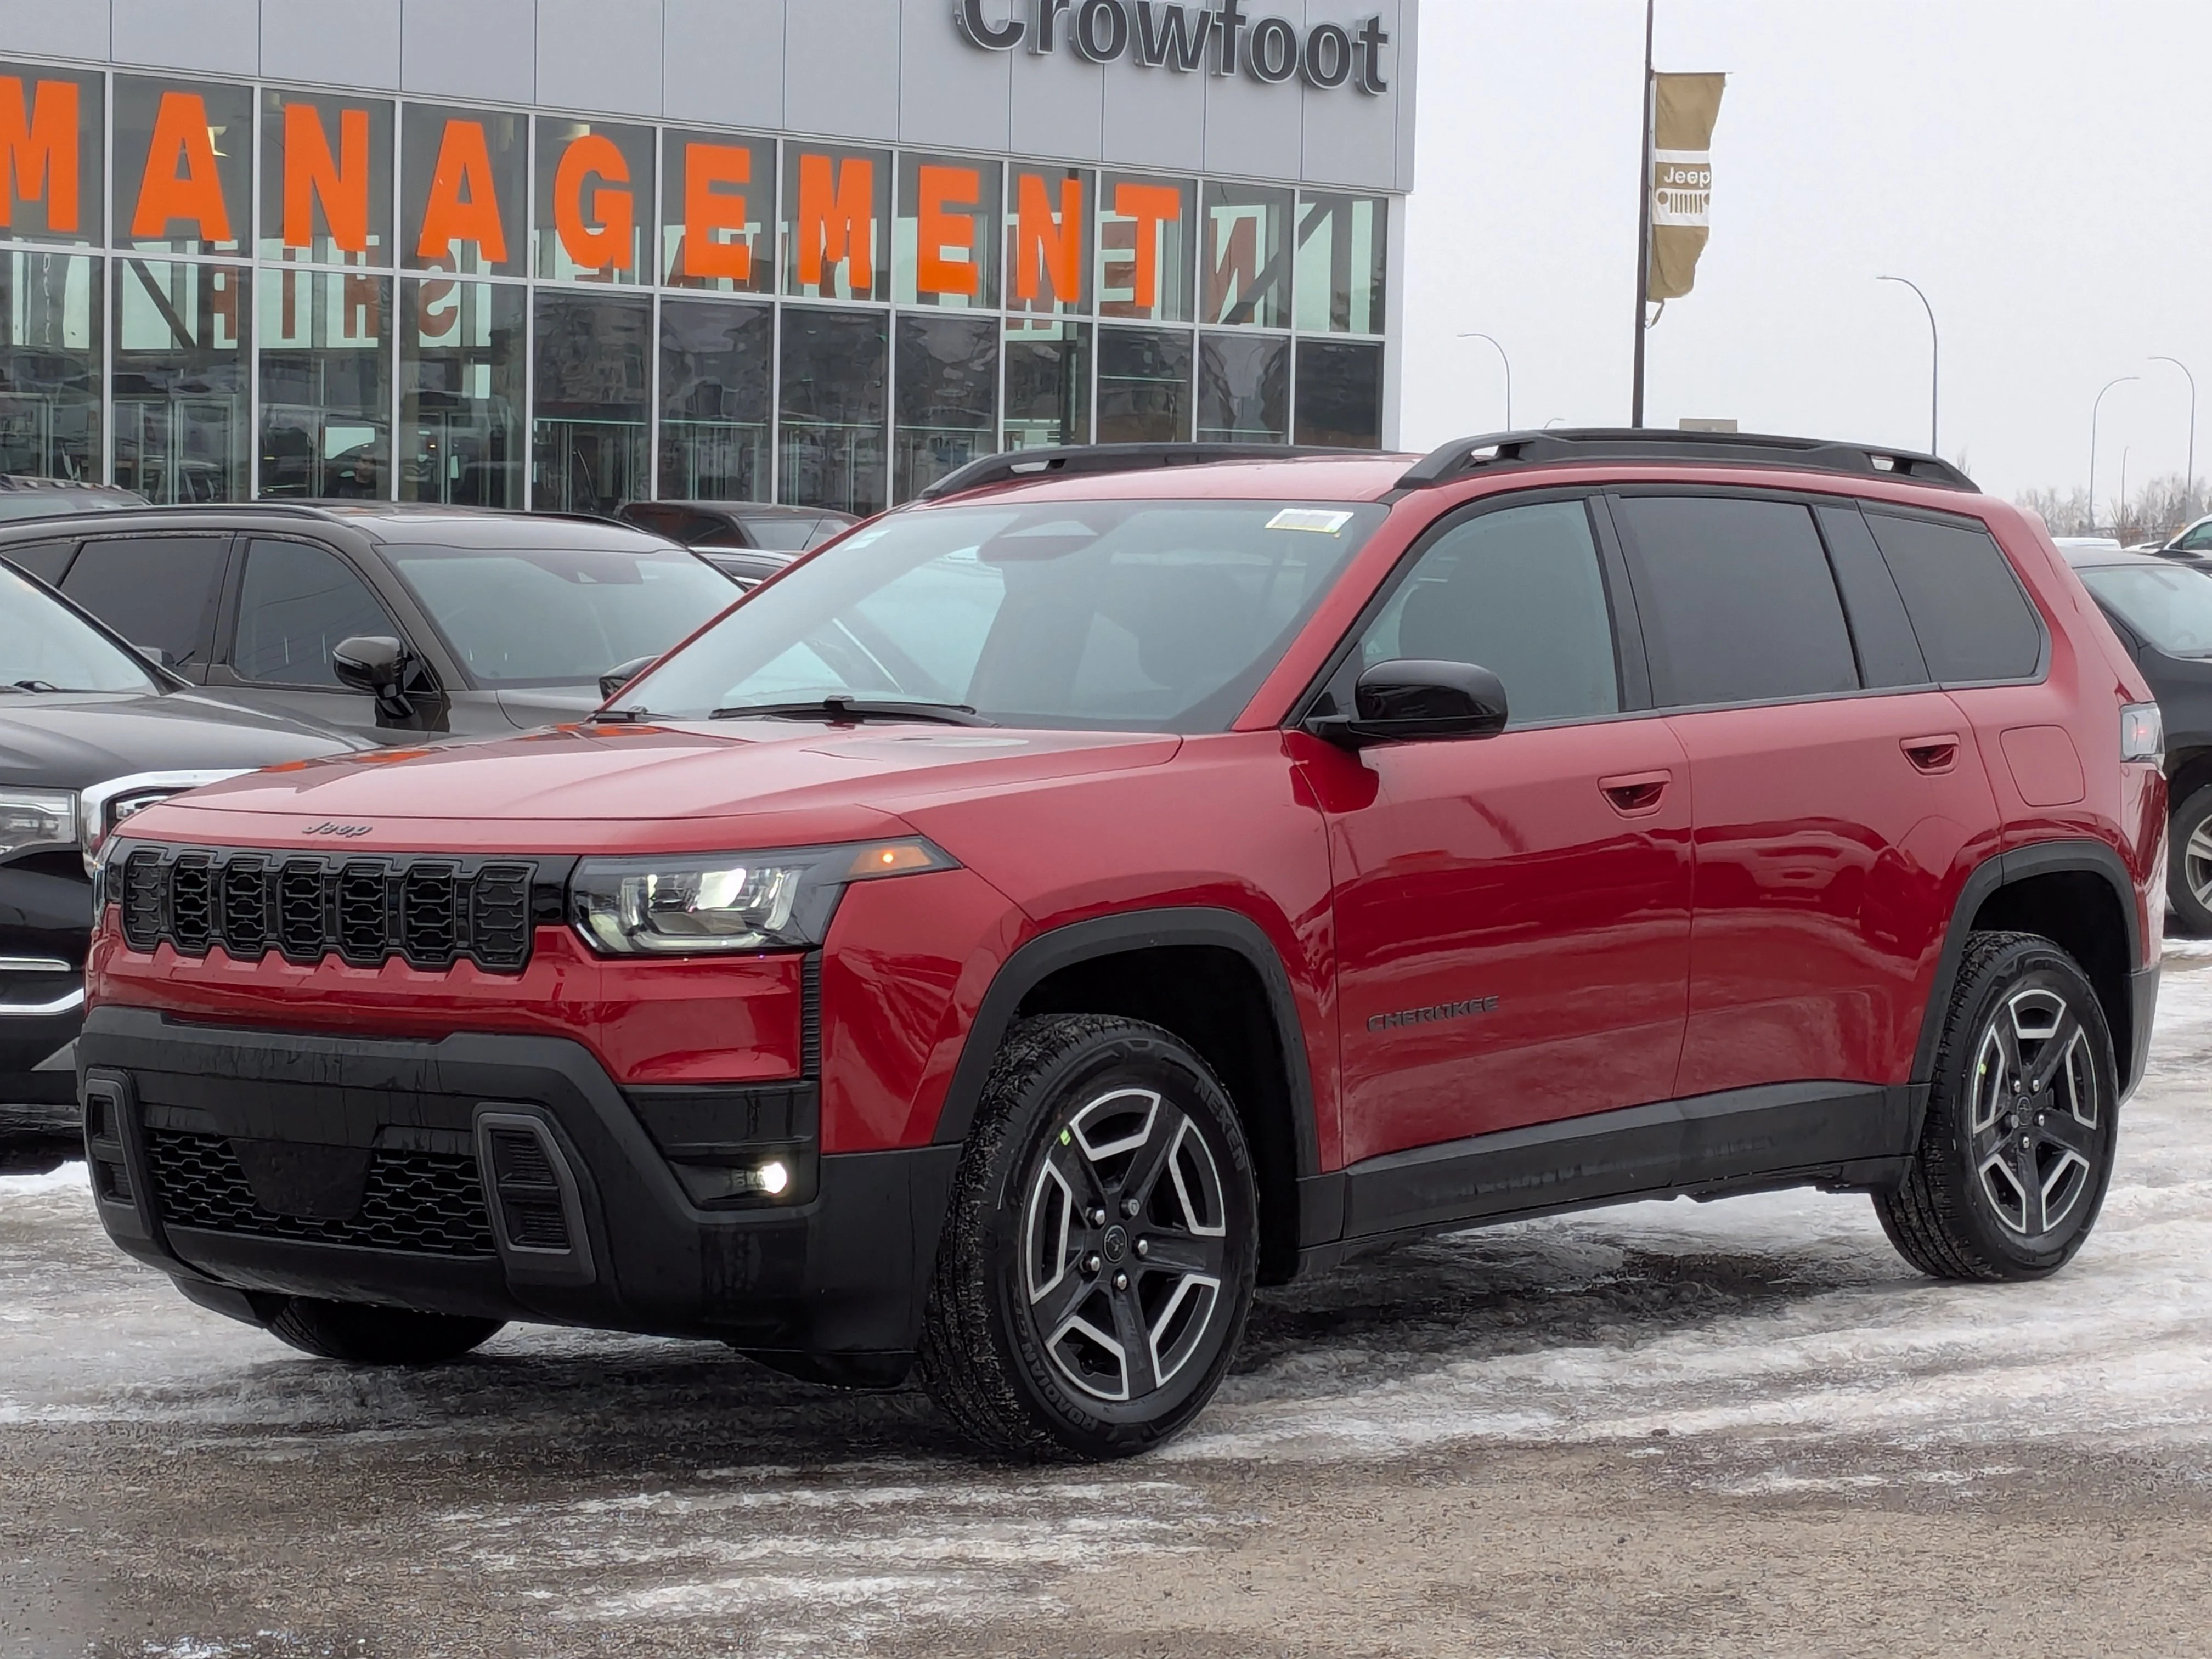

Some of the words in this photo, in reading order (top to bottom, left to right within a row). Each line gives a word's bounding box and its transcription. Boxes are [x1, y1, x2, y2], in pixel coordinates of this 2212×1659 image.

[0, 76, 1180, 307] MANAGEMENT
[1664, 167, 1711, 187] Jeep
[302, 822, 373, 838] Jeep
[1367, 995, 1499, 1032] CHEROKEE
[1193, 1077, 1246, 1172] NEXEN
[1021, 1342, 1099, 1431] ROADIAN
